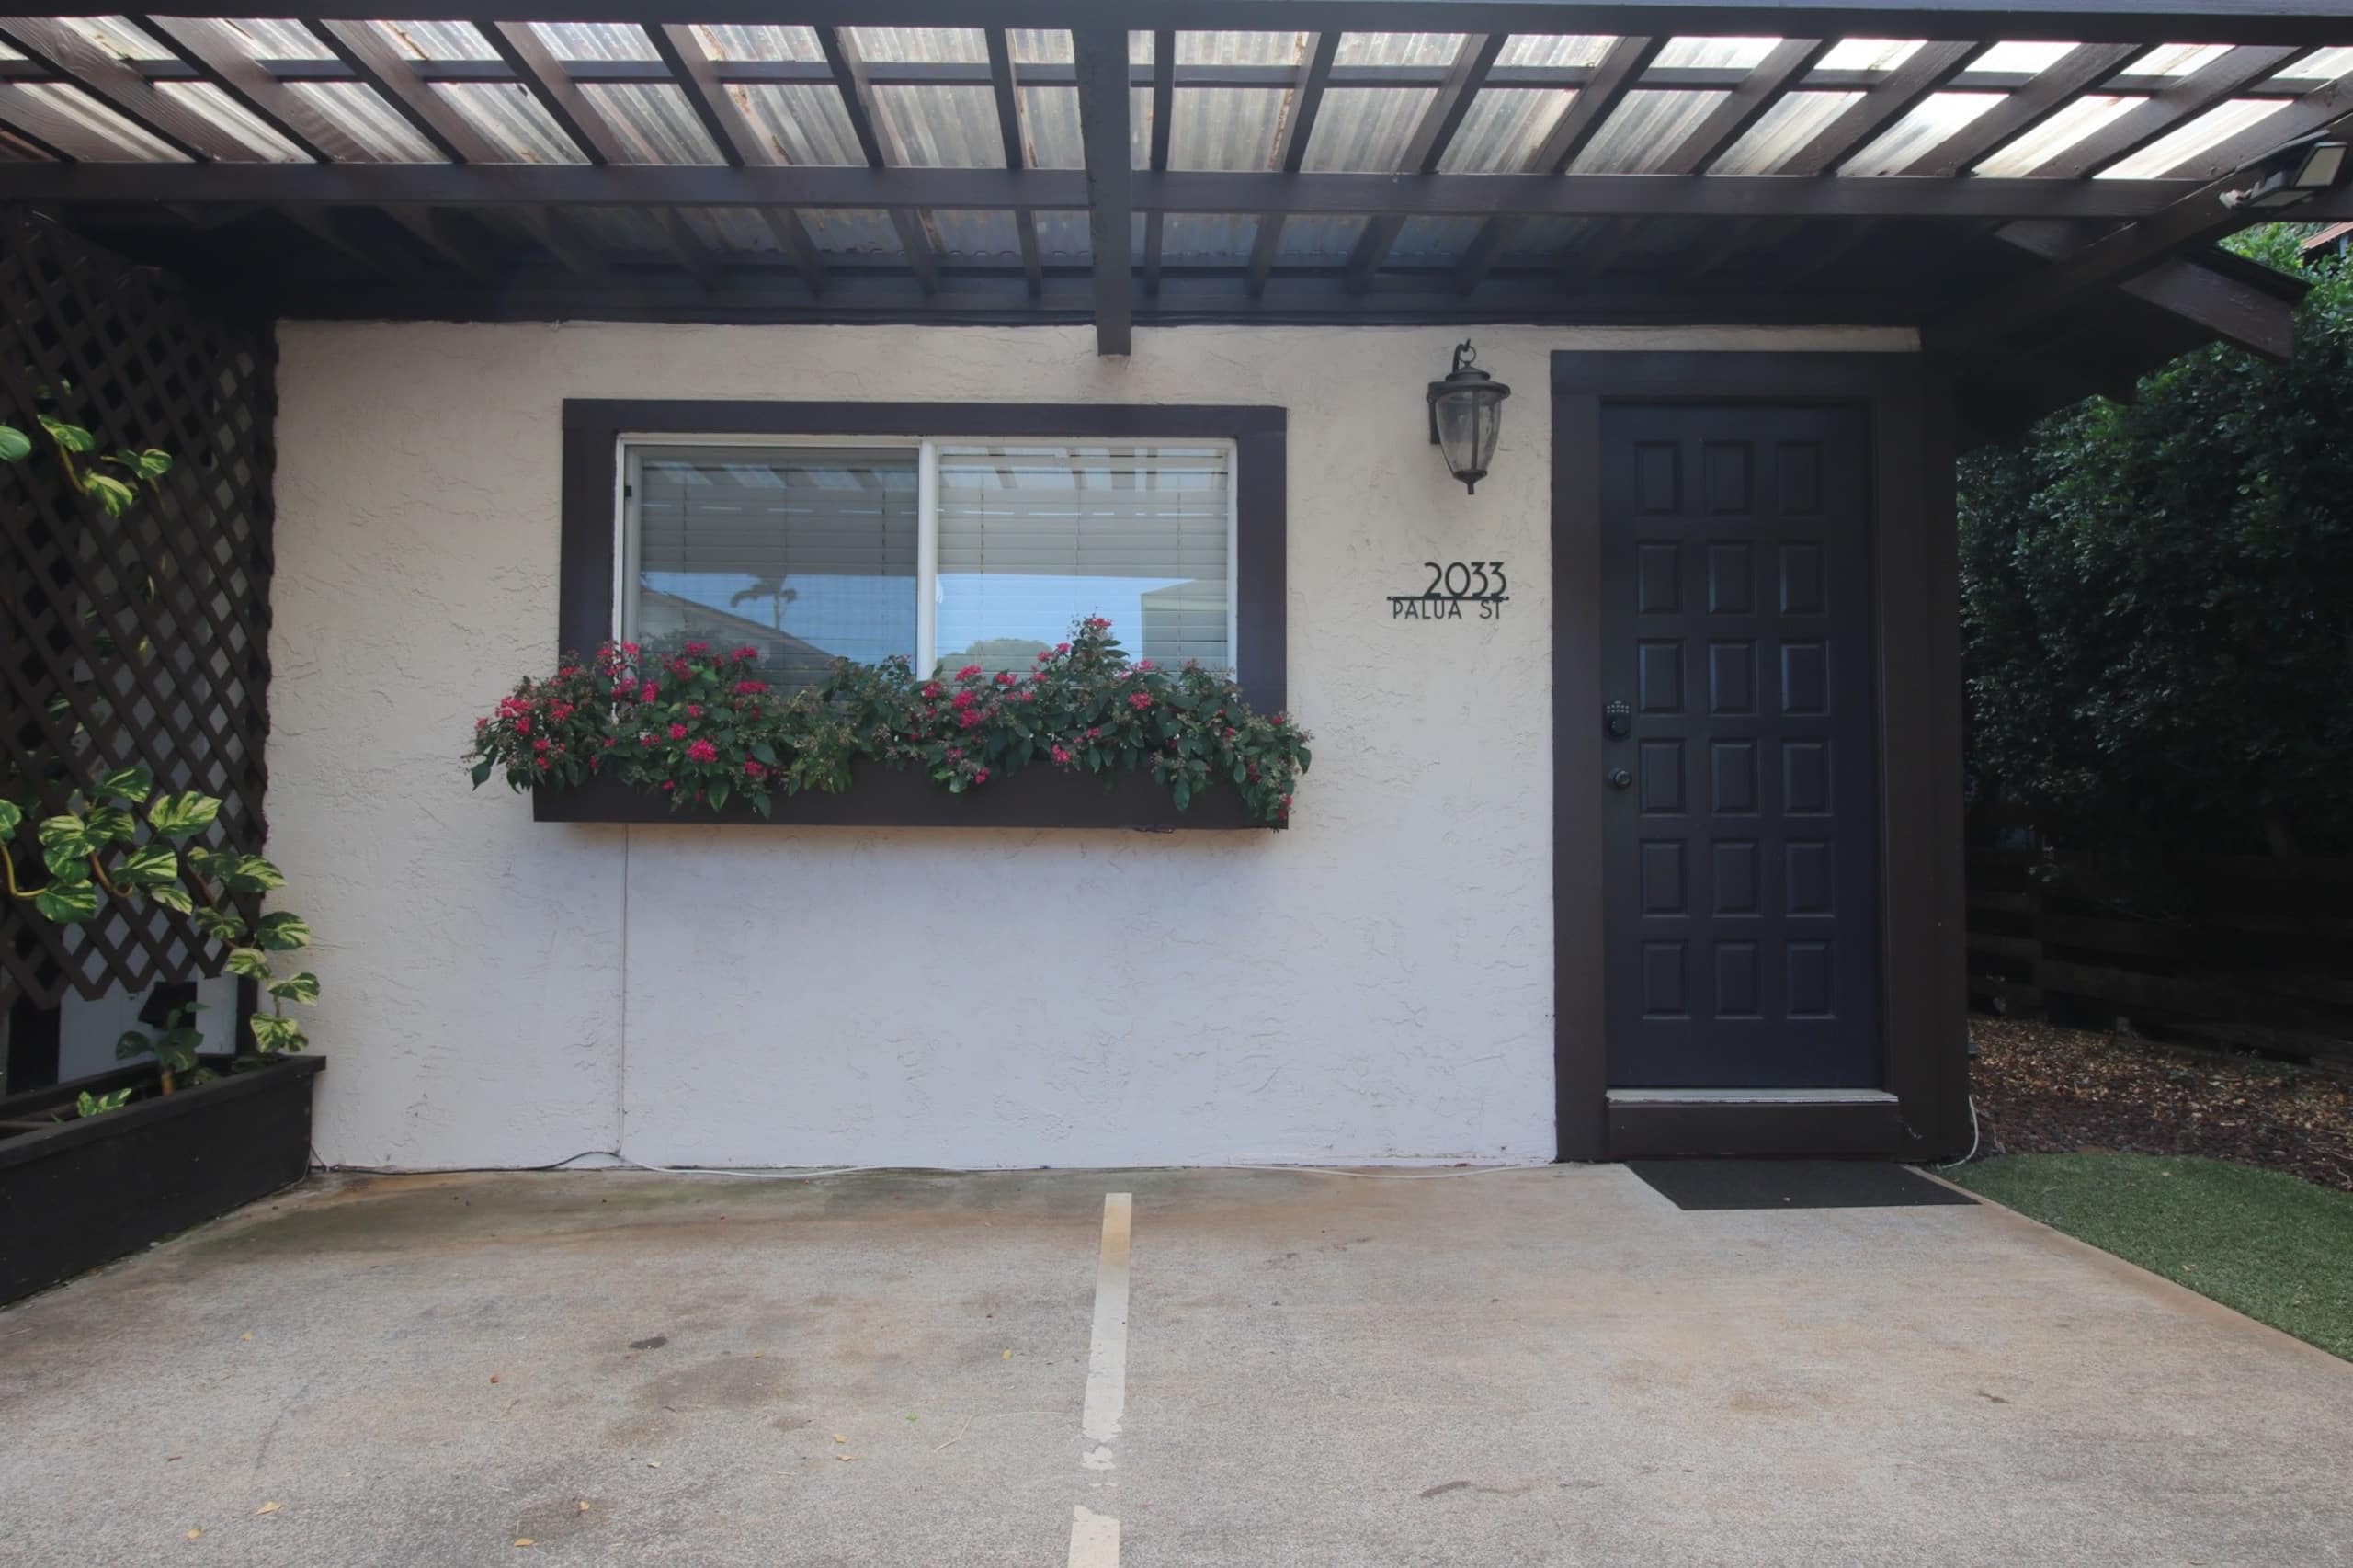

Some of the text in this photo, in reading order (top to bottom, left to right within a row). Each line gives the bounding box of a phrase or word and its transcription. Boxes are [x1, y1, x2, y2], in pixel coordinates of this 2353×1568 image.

[1424, 562, 1507, 597] 2033
[1392, 597, 1503, 619] PALUA ST
